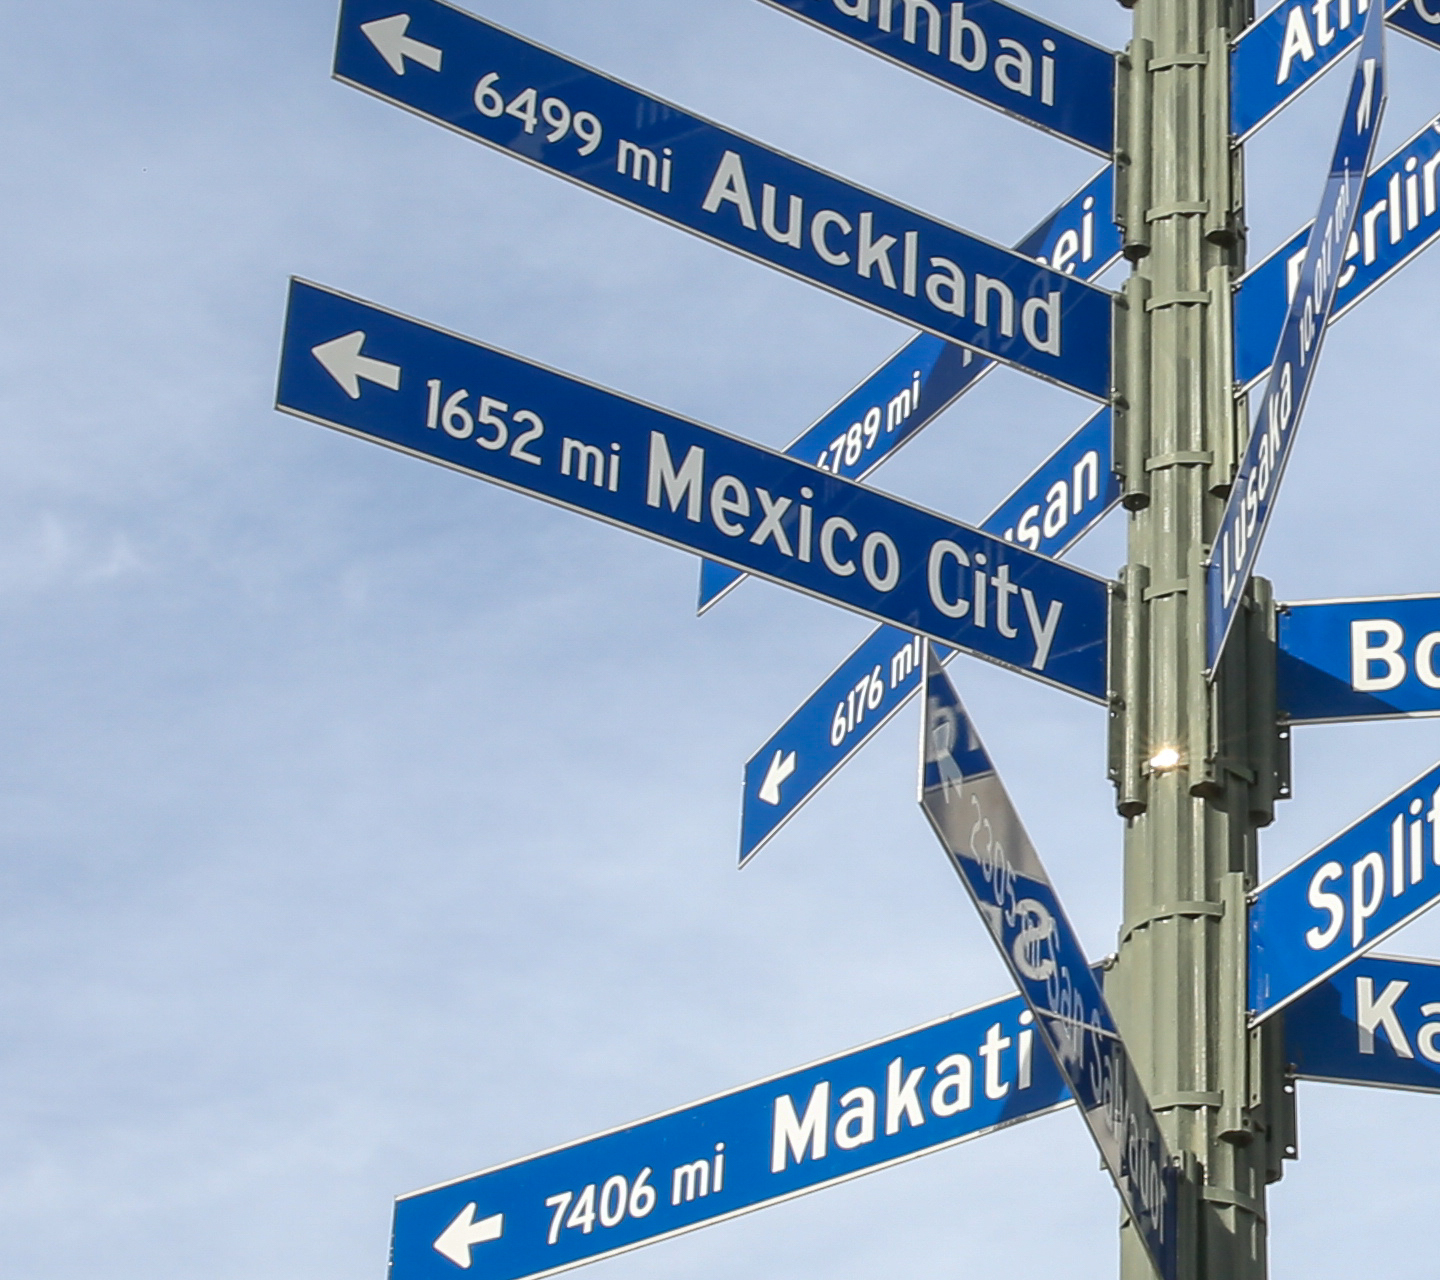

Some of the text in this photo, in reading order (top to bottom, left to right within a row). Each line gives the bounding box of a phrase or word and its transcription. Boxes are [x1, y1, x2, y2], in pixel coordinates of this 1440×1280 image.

[473, 72, 603, 157] 6499
[616, 136, 673, 194] mi
[701, 149, 1062, 358] Auckland
[886, 370, 921, 433] mi
[1222, 360, 1293, 609] Lusaka
[1335, 156, 1350, 243] mi
[426, 378, 1064, 670] 1652 mi Mexico City
[829, 634, 921, 748] 6176 mi
[544, 1009, 1034, 1245] 7406 mi Makati
